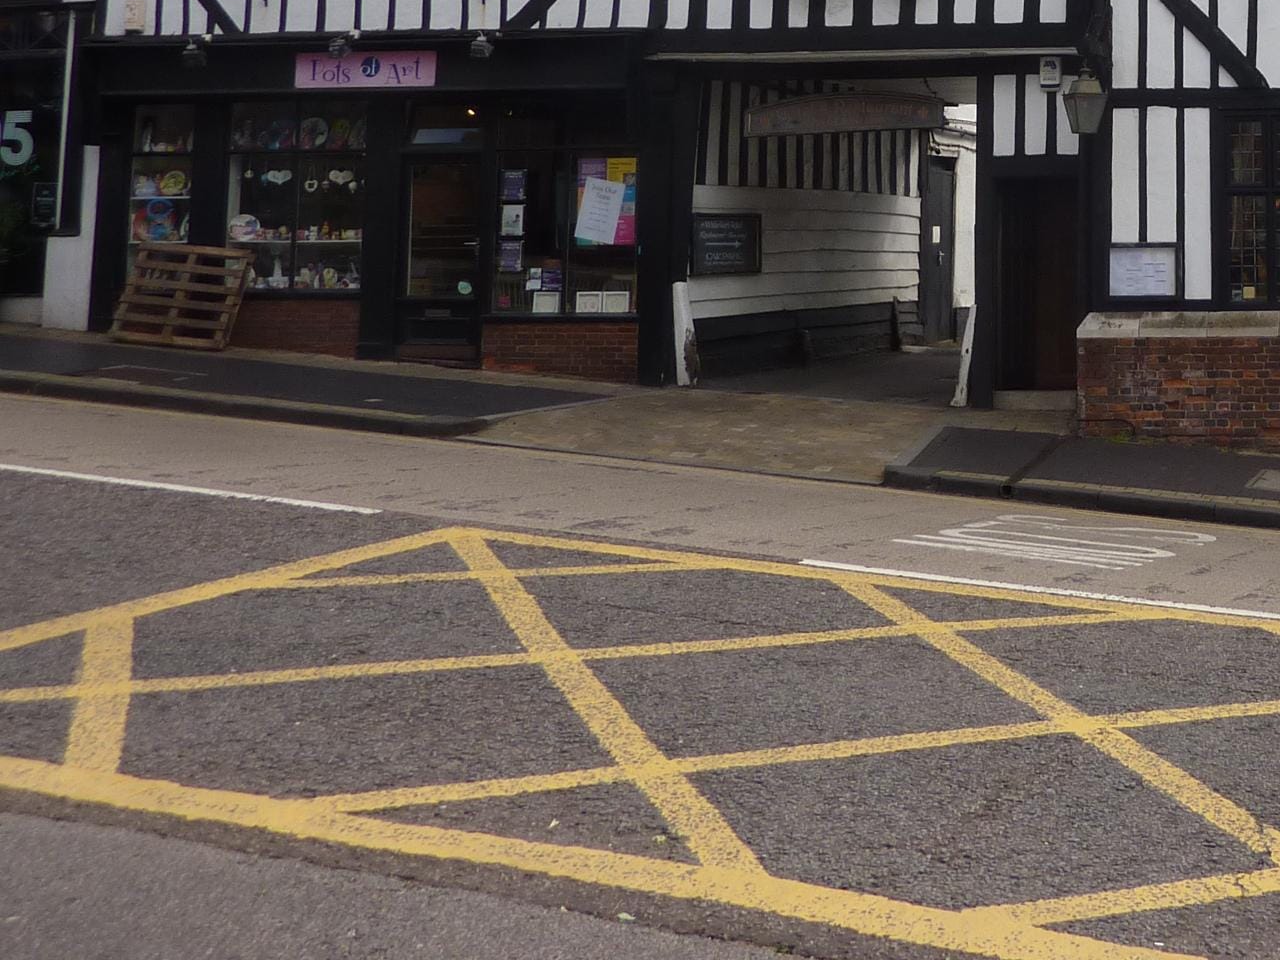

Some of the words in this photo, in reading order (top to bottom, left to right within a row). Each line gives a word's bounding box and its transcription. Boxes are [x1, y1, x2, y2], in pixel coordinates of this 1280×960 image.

[310, 59, 351, 84] Pots
[360, 58, 377, 76] of
[384, 56, 422, 84] Art
[0, 110, 34, 166] 5
